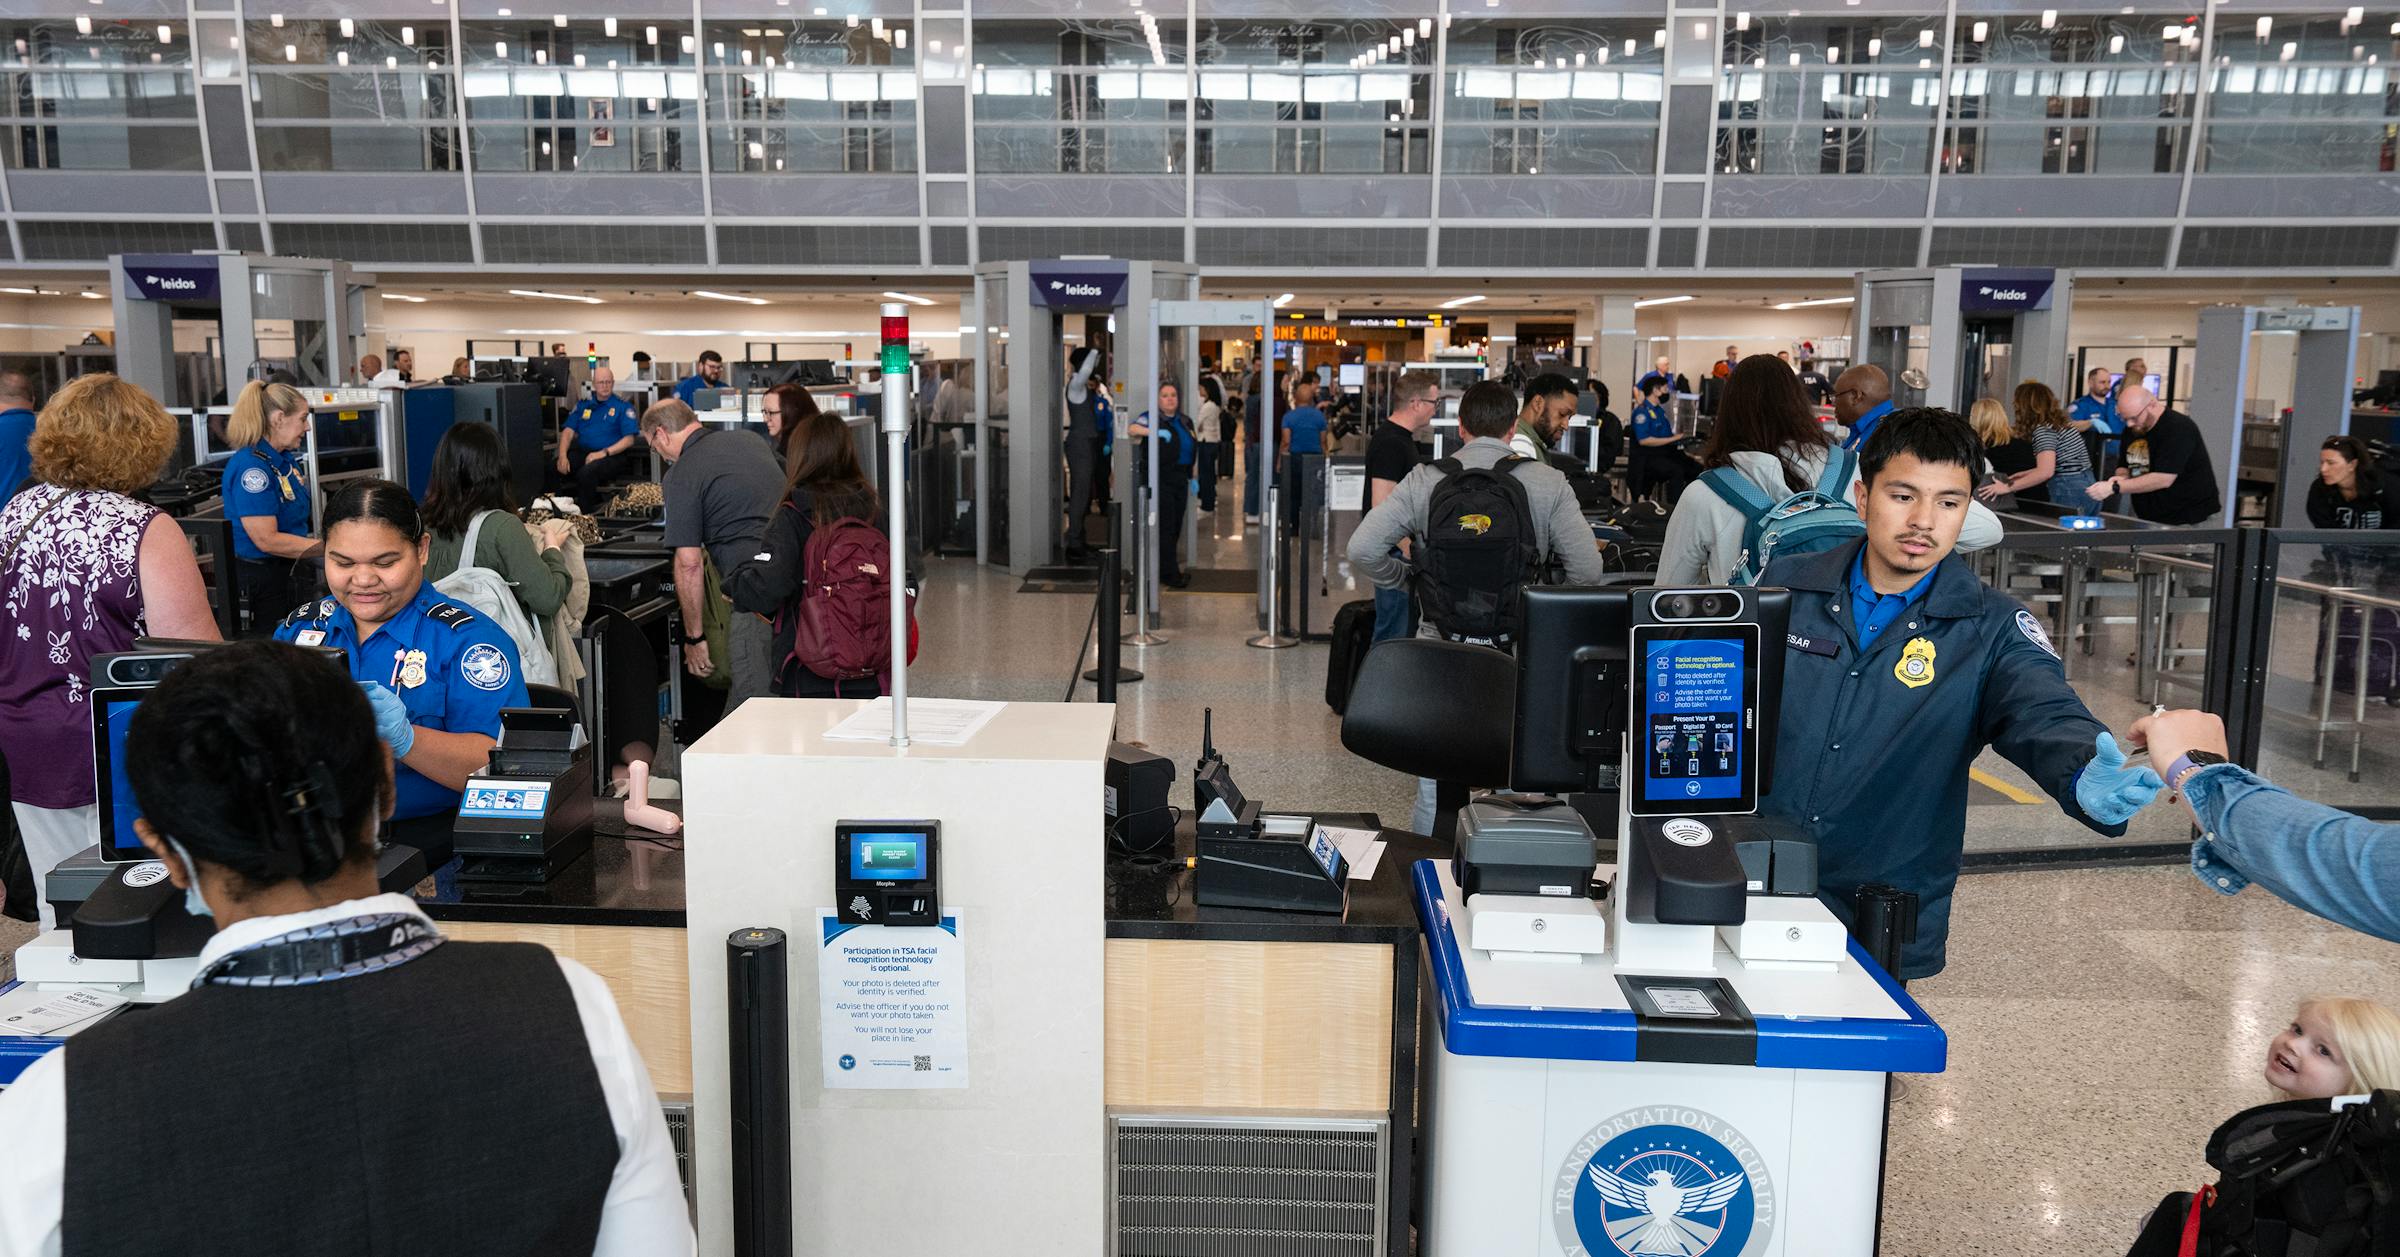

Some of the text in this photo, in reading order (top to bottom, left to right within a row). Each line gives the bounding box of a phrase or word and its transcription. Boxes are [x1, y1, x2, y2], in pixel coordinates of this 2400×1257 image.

[160, 277, 197, 290] leidos
[1065, 283, 1102, 296] leidos
[1992, 288, 2027, 301] leidos
[1255, 325, 1337, 341] SONE ARCH
[438, 606, 462, 620] TSA
[843, 947, 938, 955] Participation in TSA facial
[848, 956, 934, 964] recognition technology
[878, 965, 912, 973] optional.
[862, 980, 884, 988] photo
[922, 980, 941, 988] after
[857, 989, 886, 997] identity
[876, 1003, 900, 1011] officer
[902, 1003, 908, 1011] if
[909, 1004, 924, 1012] you
[871, 1012, 888, 1020] your
[889, 1011, 912, 1020] photo
[912, 1011, 935, 1019] taken.
[870, 1026, 883, 1034] will
[884, 1026, 897, 1034] not
[898, 1026, 914, 1034] lose
[915, 1027, 933, 1035] your
[871, 1034, 891, 1042] place
[892, 1034, 900, 1042] in
[1555, 1107, 1773, 1228] TRANSPORTATION SECURITY
